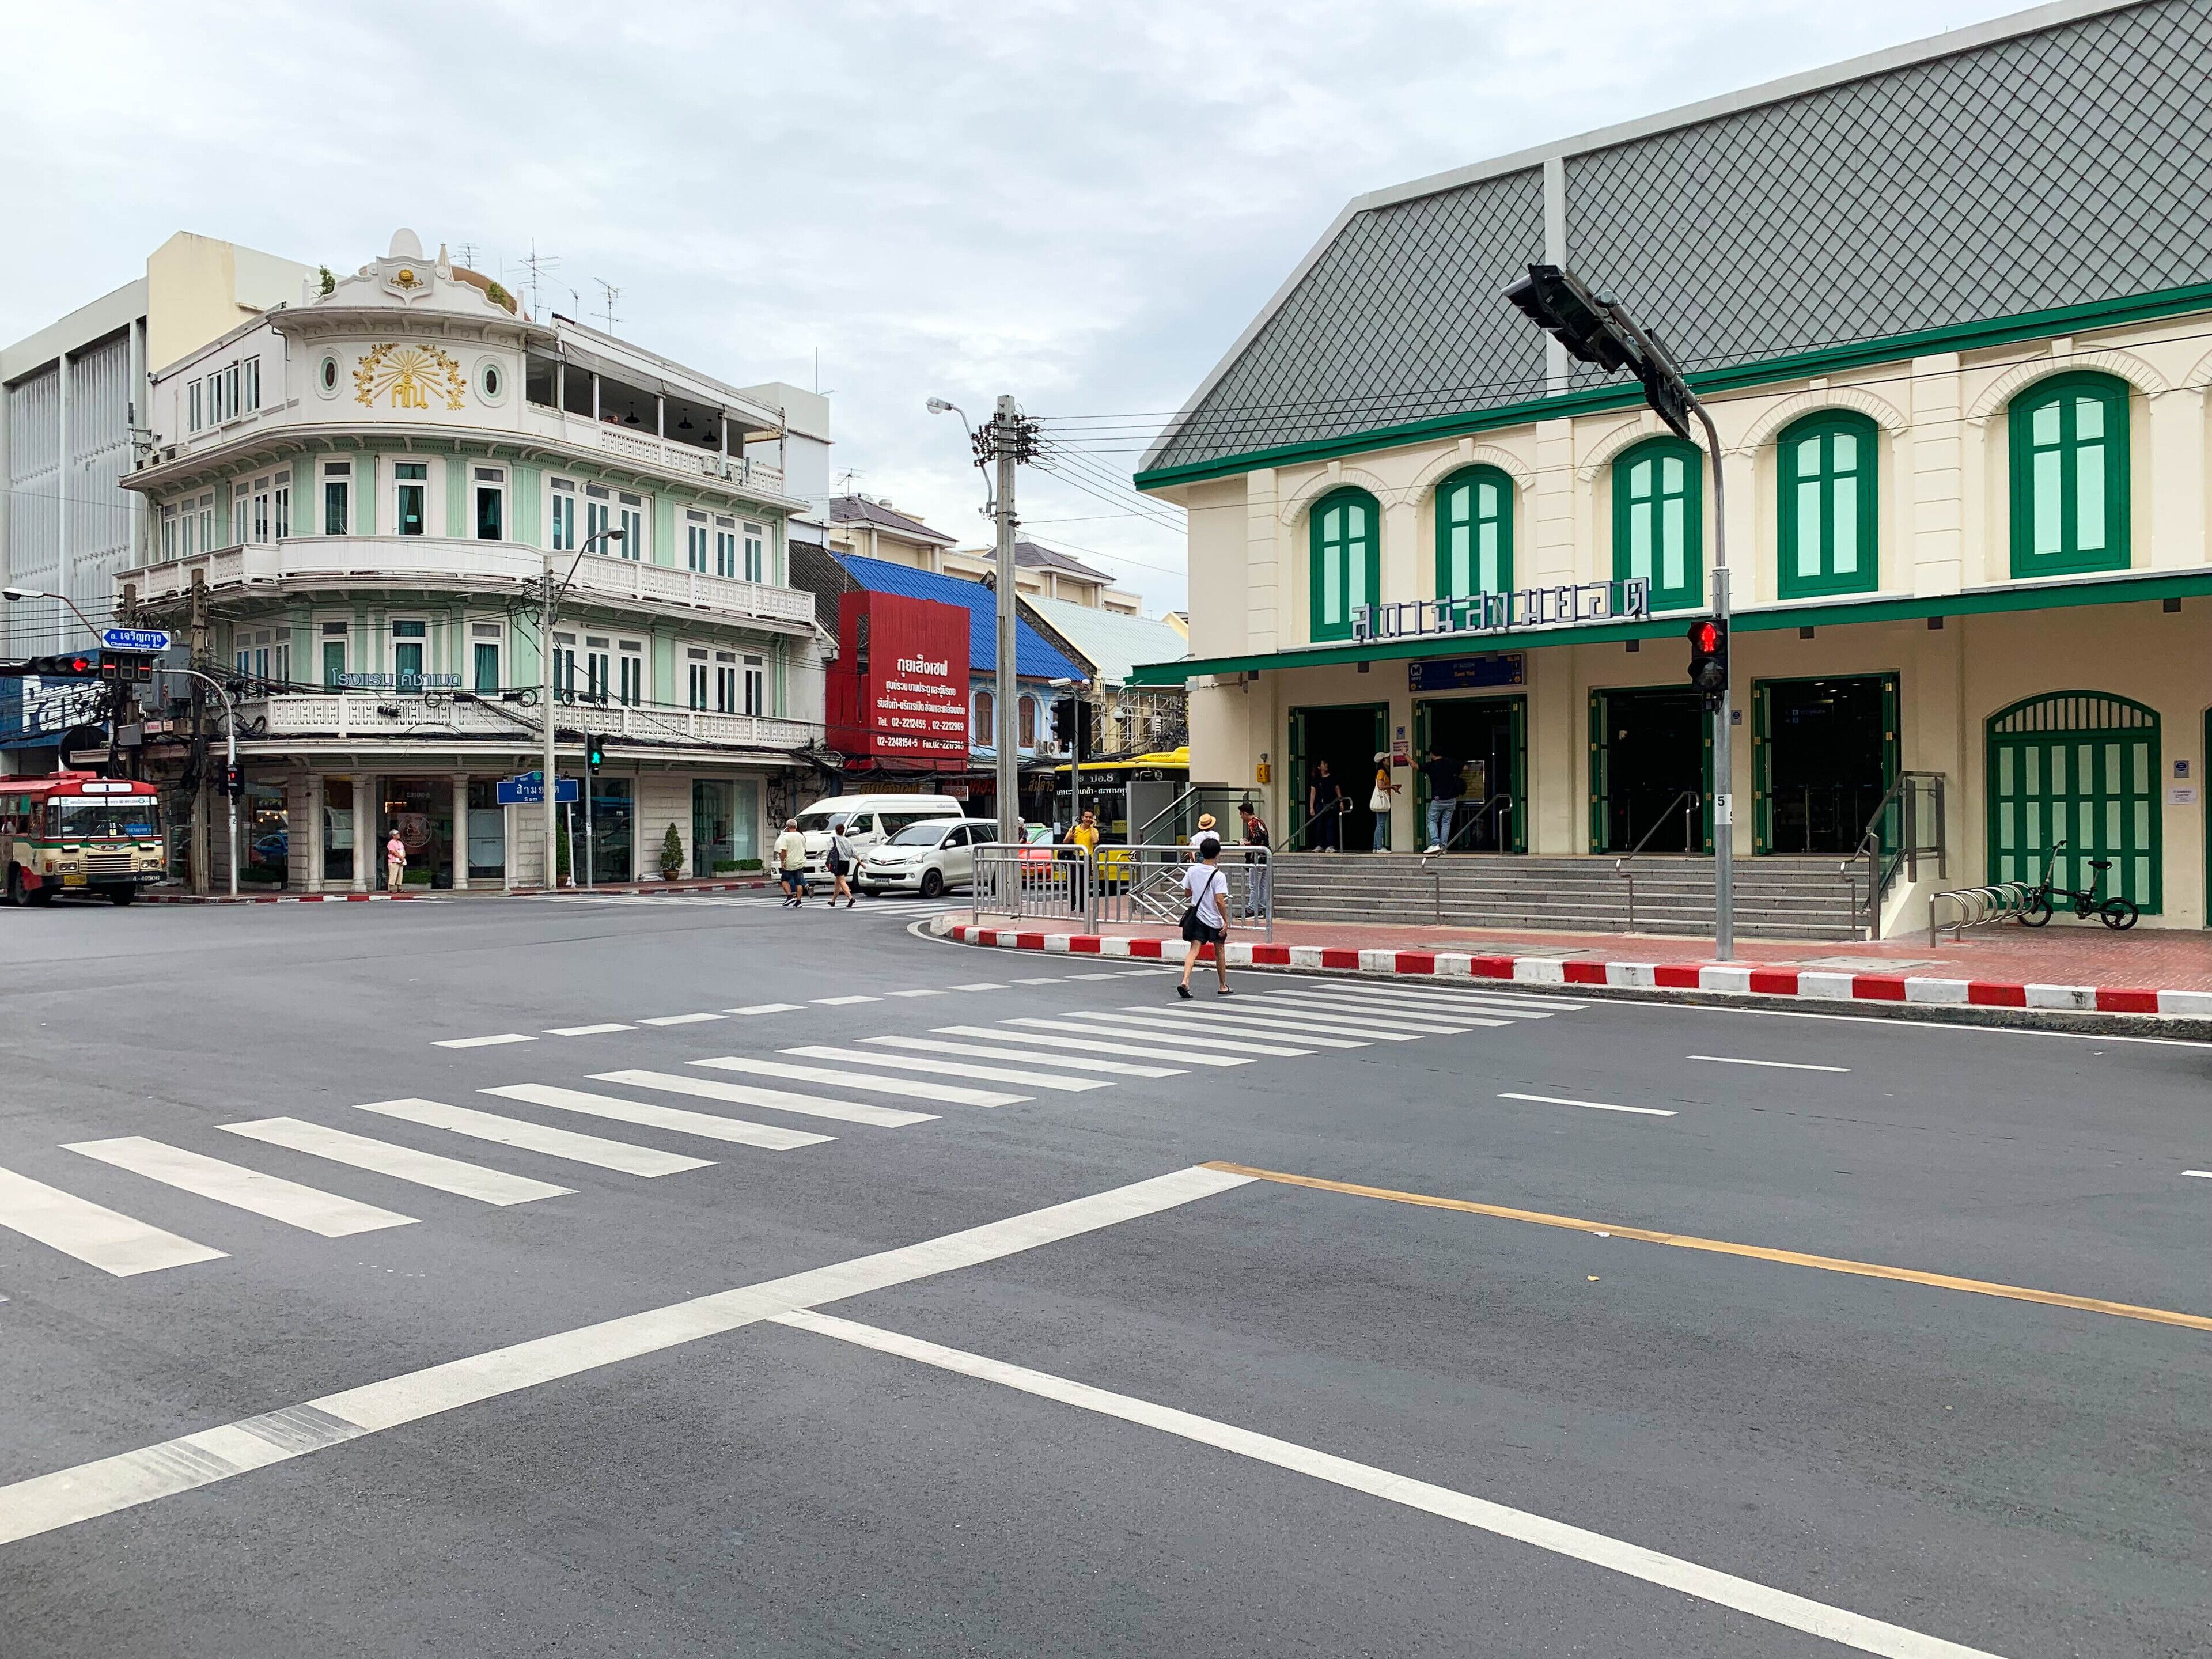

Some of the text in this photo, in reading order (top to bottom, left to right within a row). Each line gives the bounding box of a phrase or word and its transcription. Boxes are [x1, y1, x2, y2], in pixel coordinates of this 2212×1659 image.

[1352, 577, 1650, 641] สถานีสามยอด
[120, 631, 161, 644] เจริญกรุง
[331, 668, 394, 687] โรงแรม
[891, 717, 926, 729] 02-2212455
[932, 720, 964, 732] 02-2212969
[1090, 773, 1114, 783] ปอ.8
[516, 783, 559, 795] สามยด
[1718, 796, 1725, 806] 5
